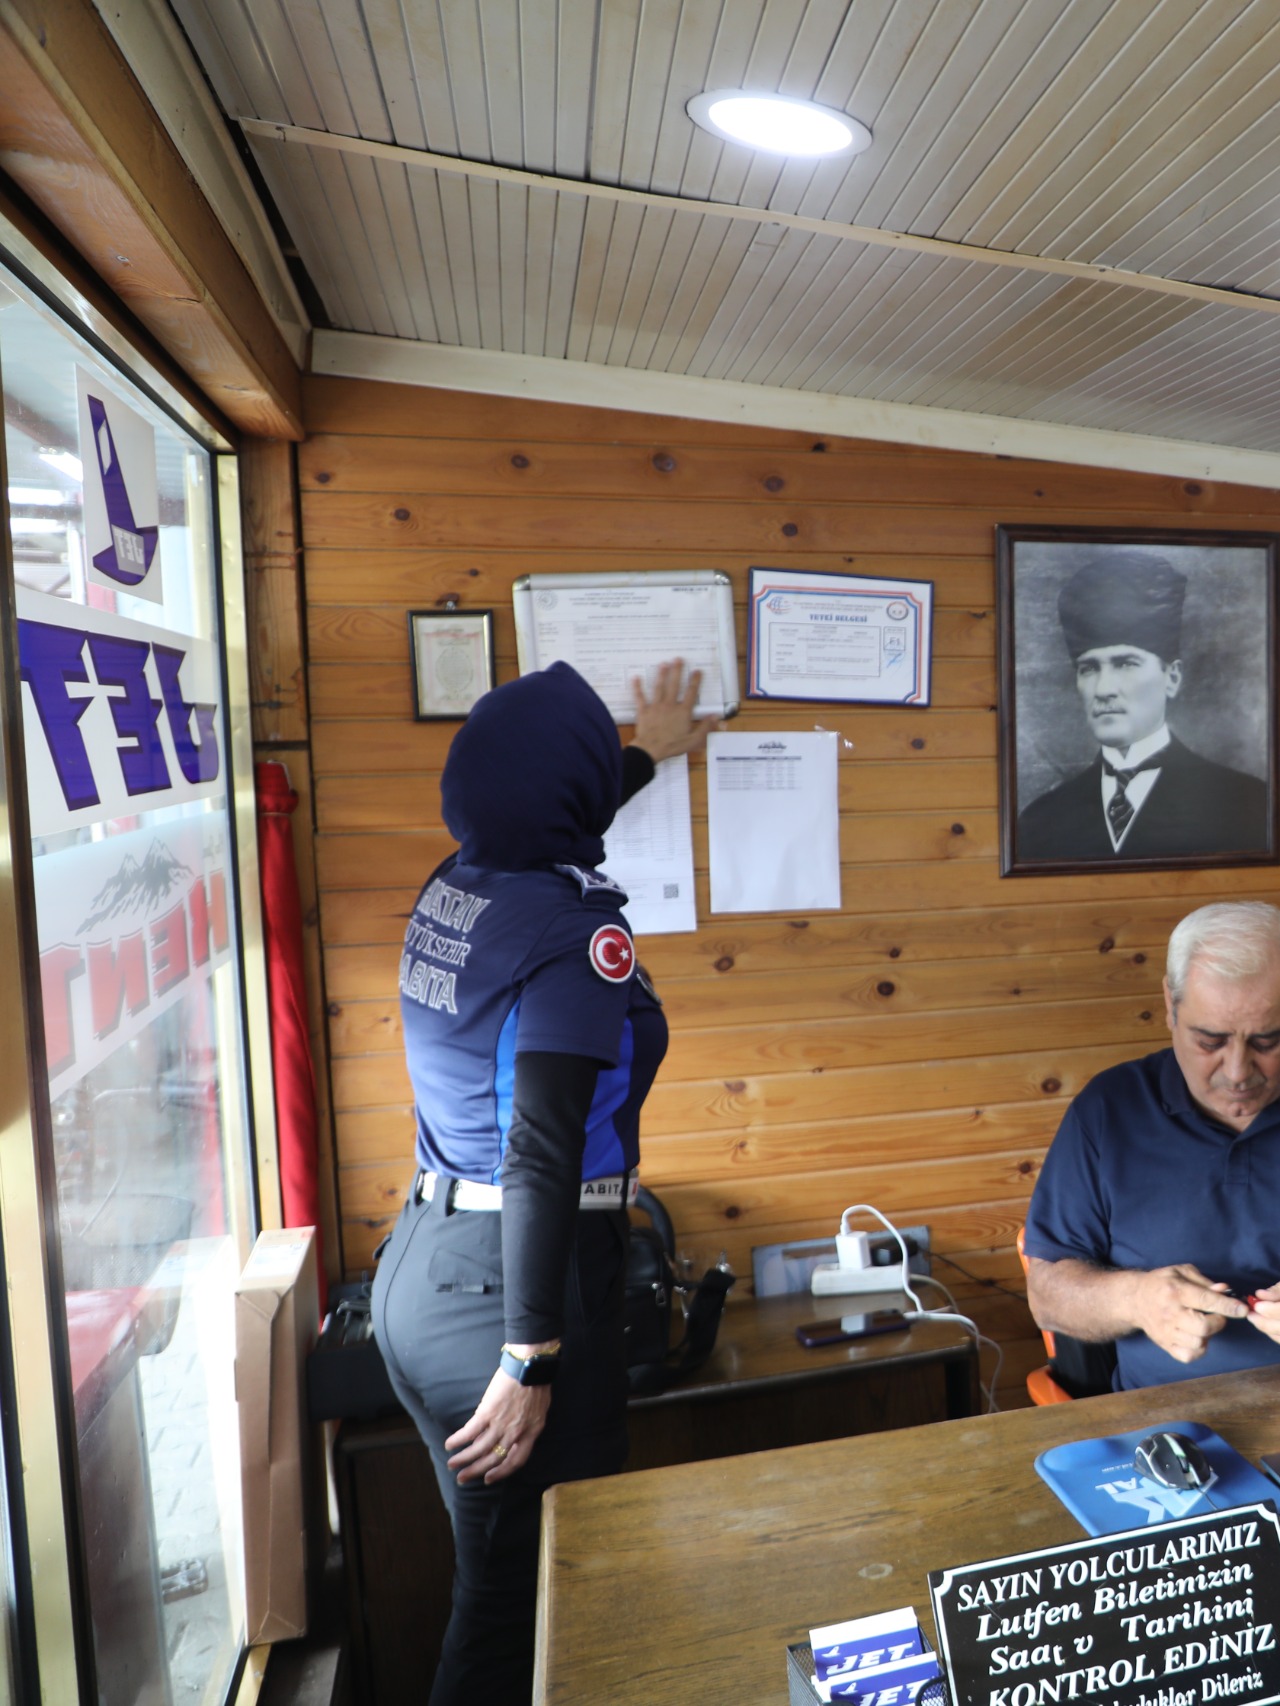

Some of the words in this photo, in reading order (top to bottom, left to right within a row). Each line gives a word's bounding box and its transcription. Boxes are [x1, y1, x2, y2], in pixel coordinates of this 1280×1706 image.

[404, 914, 471, 968] ÜYÜKŞEHİR
[398, 953, 458, 1015] ABITA
[584, 1183, 622, 1194] ABIT
[957, 1568, 1043, 1612] SAYIN
[1049, 1522, 1260, 1590] YOLCULARIMIZ
[976, 1601, 1082, 1641] Lutfen
[1093, 1559, 1254, 1615] Biletinizin
[826, 1642, 914, 1675] JET
[989, 1644, 1065, 1675] Saat
[1120, 1588, 1254, 1642] Tarihini
[988, 1654, 1155, 1706] KONTROL
[1163, 1622, 1276, 1675] EDİNİZ
[1202, 1667, 1263, 1701] Dileriz
